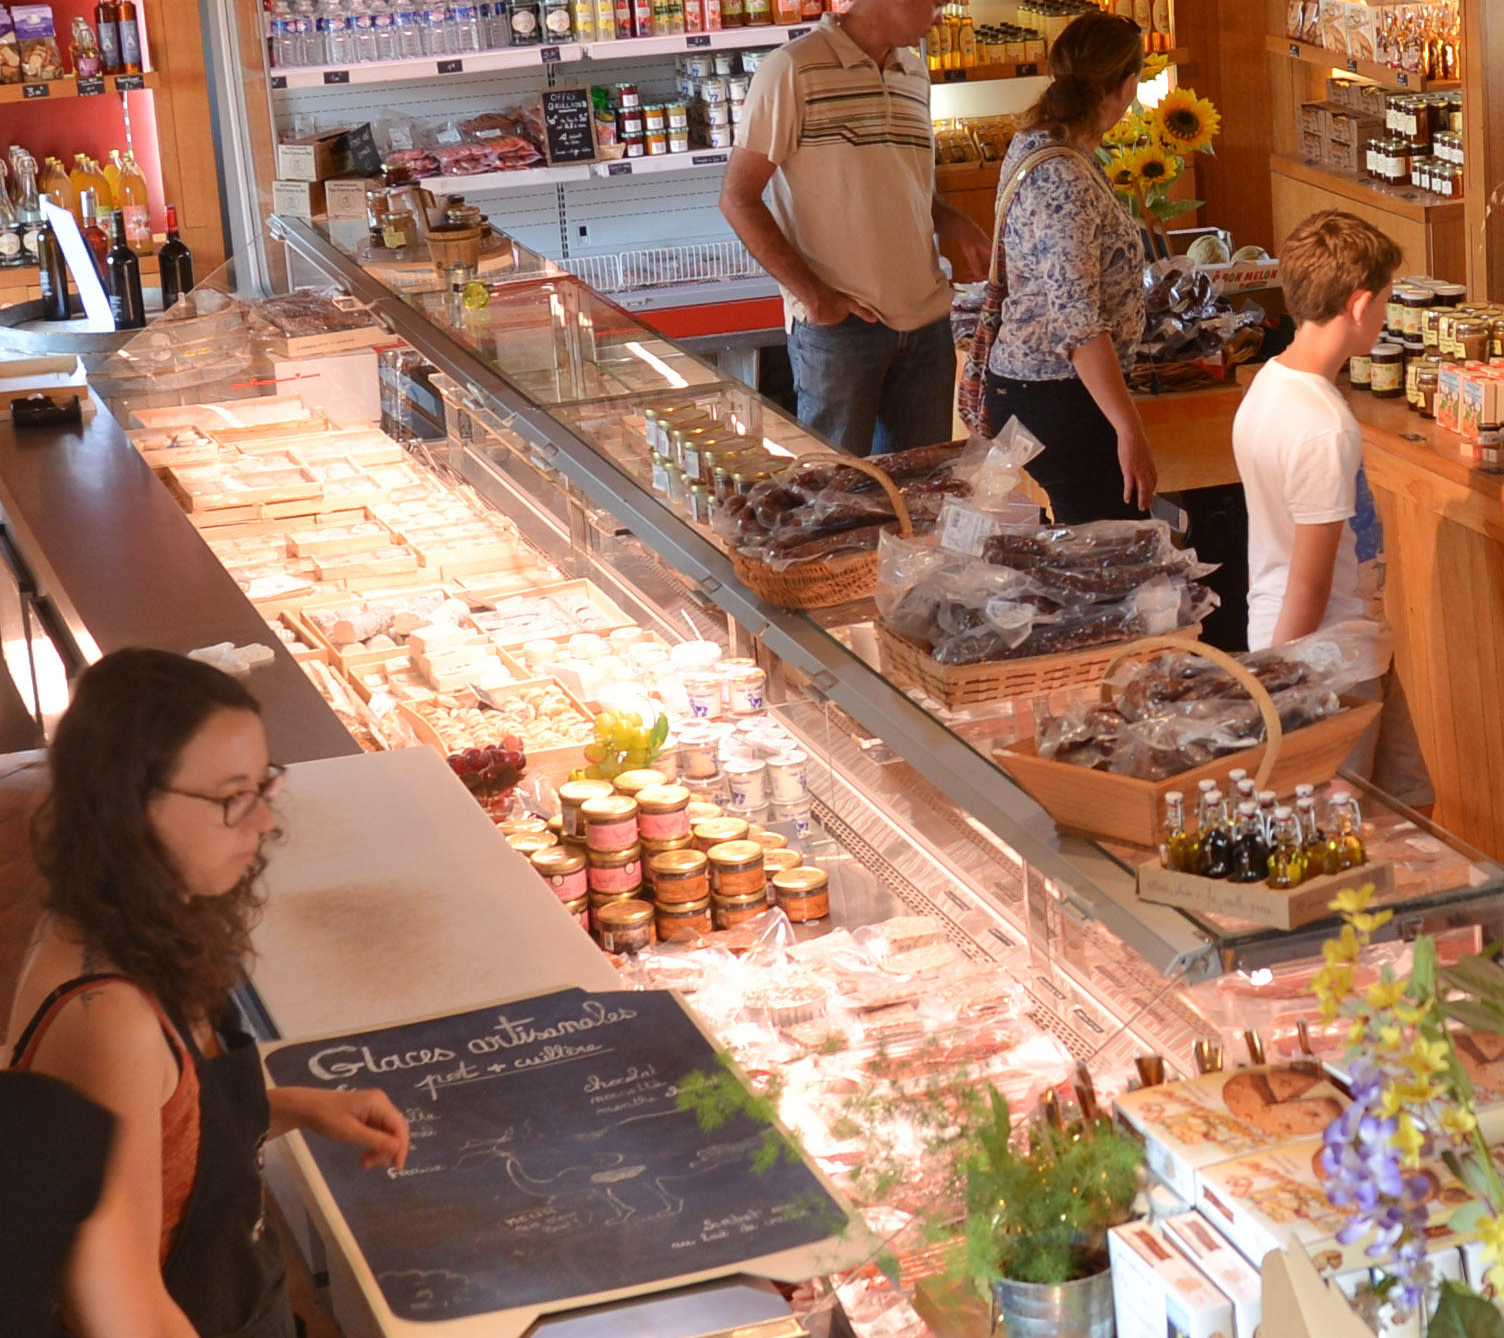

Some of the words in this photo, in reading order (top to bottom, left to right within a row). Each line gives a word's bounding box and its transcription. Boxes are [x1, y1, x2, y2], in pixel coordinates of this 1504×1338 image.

[307, 1041, 456, 1082] Glaces
[467, 1000, 638, 1055] artisanales
[415, 1062, 480, 1101] pot
[513, 1038, 604, 1072] cuillère
